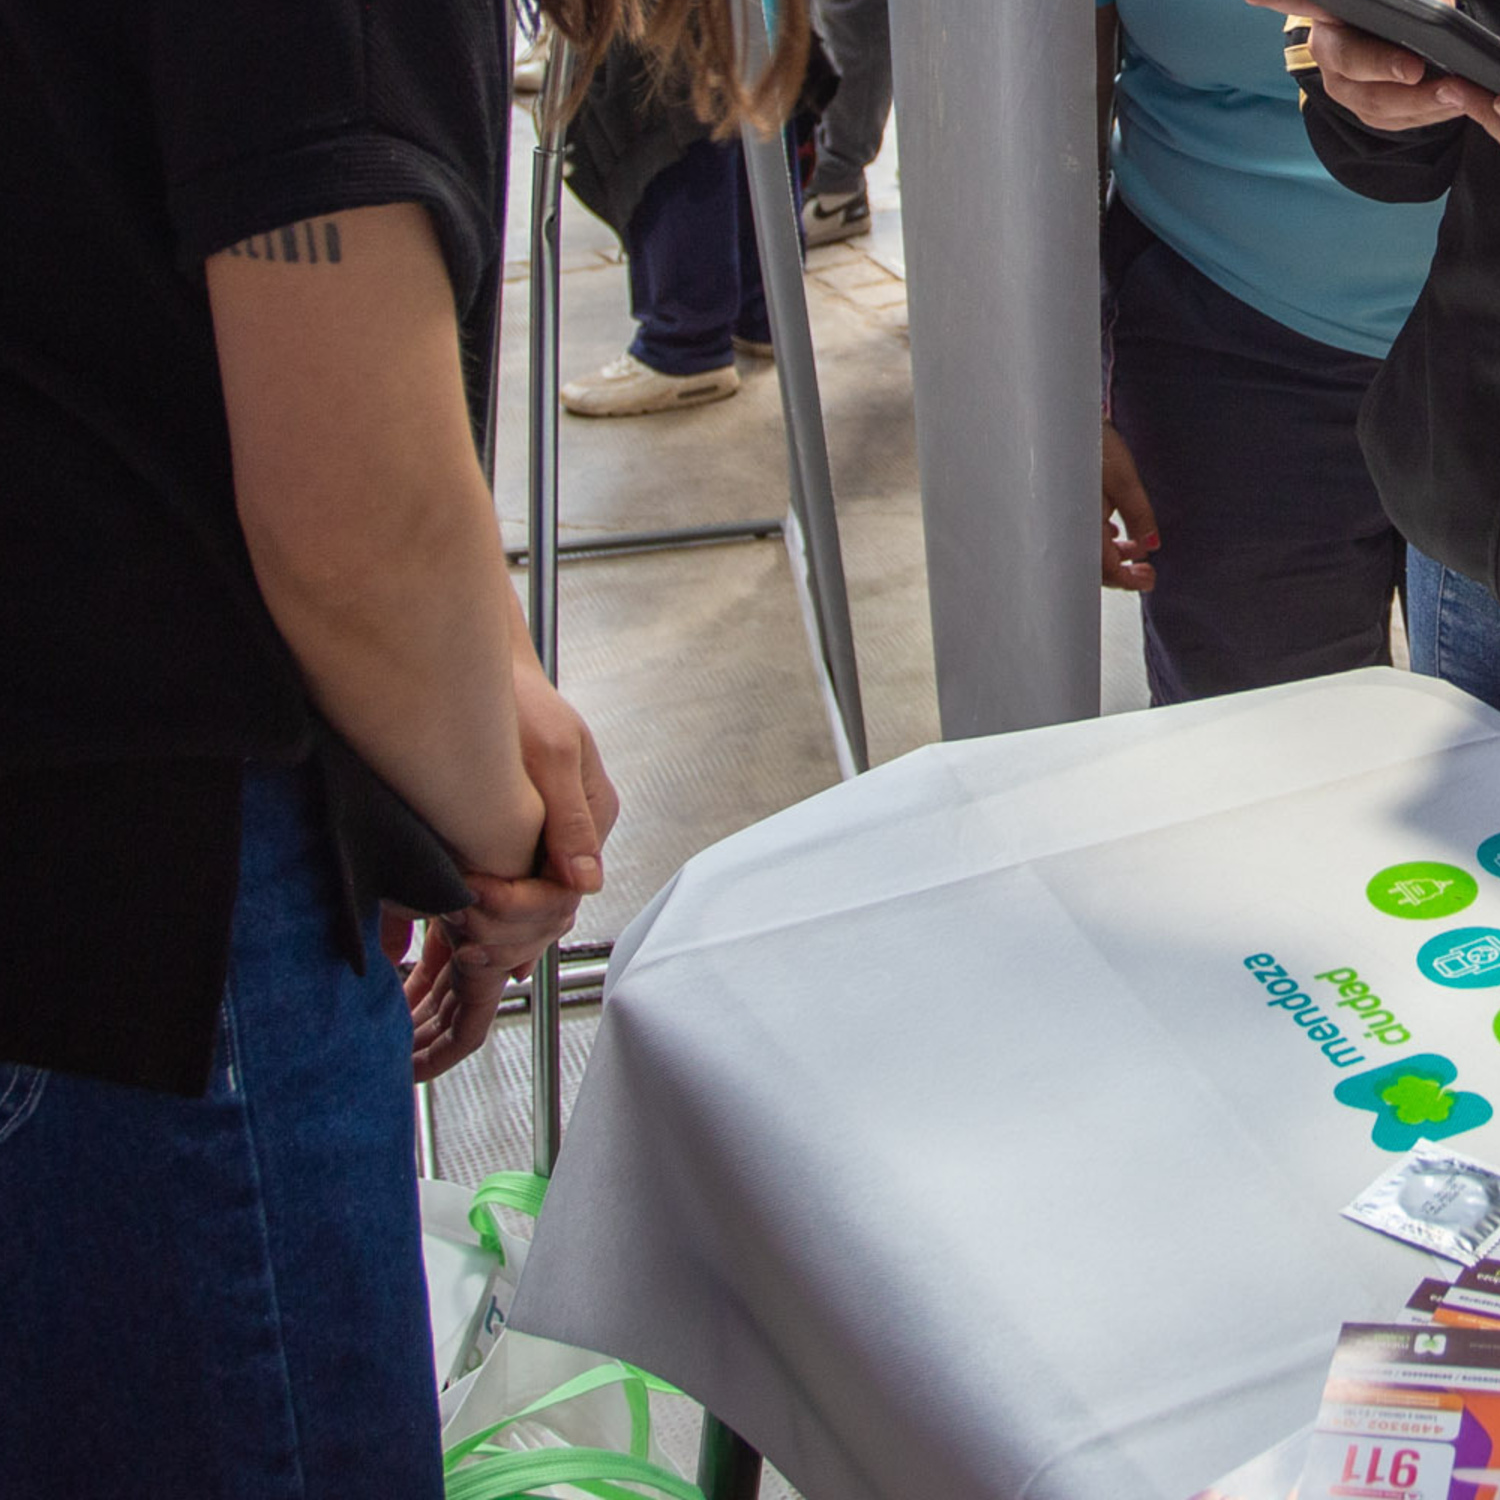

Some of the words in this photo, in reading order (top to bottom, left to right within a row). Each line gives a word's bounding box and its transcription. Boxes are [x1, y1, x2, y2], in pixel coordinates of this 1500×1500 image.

[1243, 952, 1366, 1068] mendoza
[1313, 966, 1412, 1046] ciudad
[1341, 1443, 1420, 1489] 911
